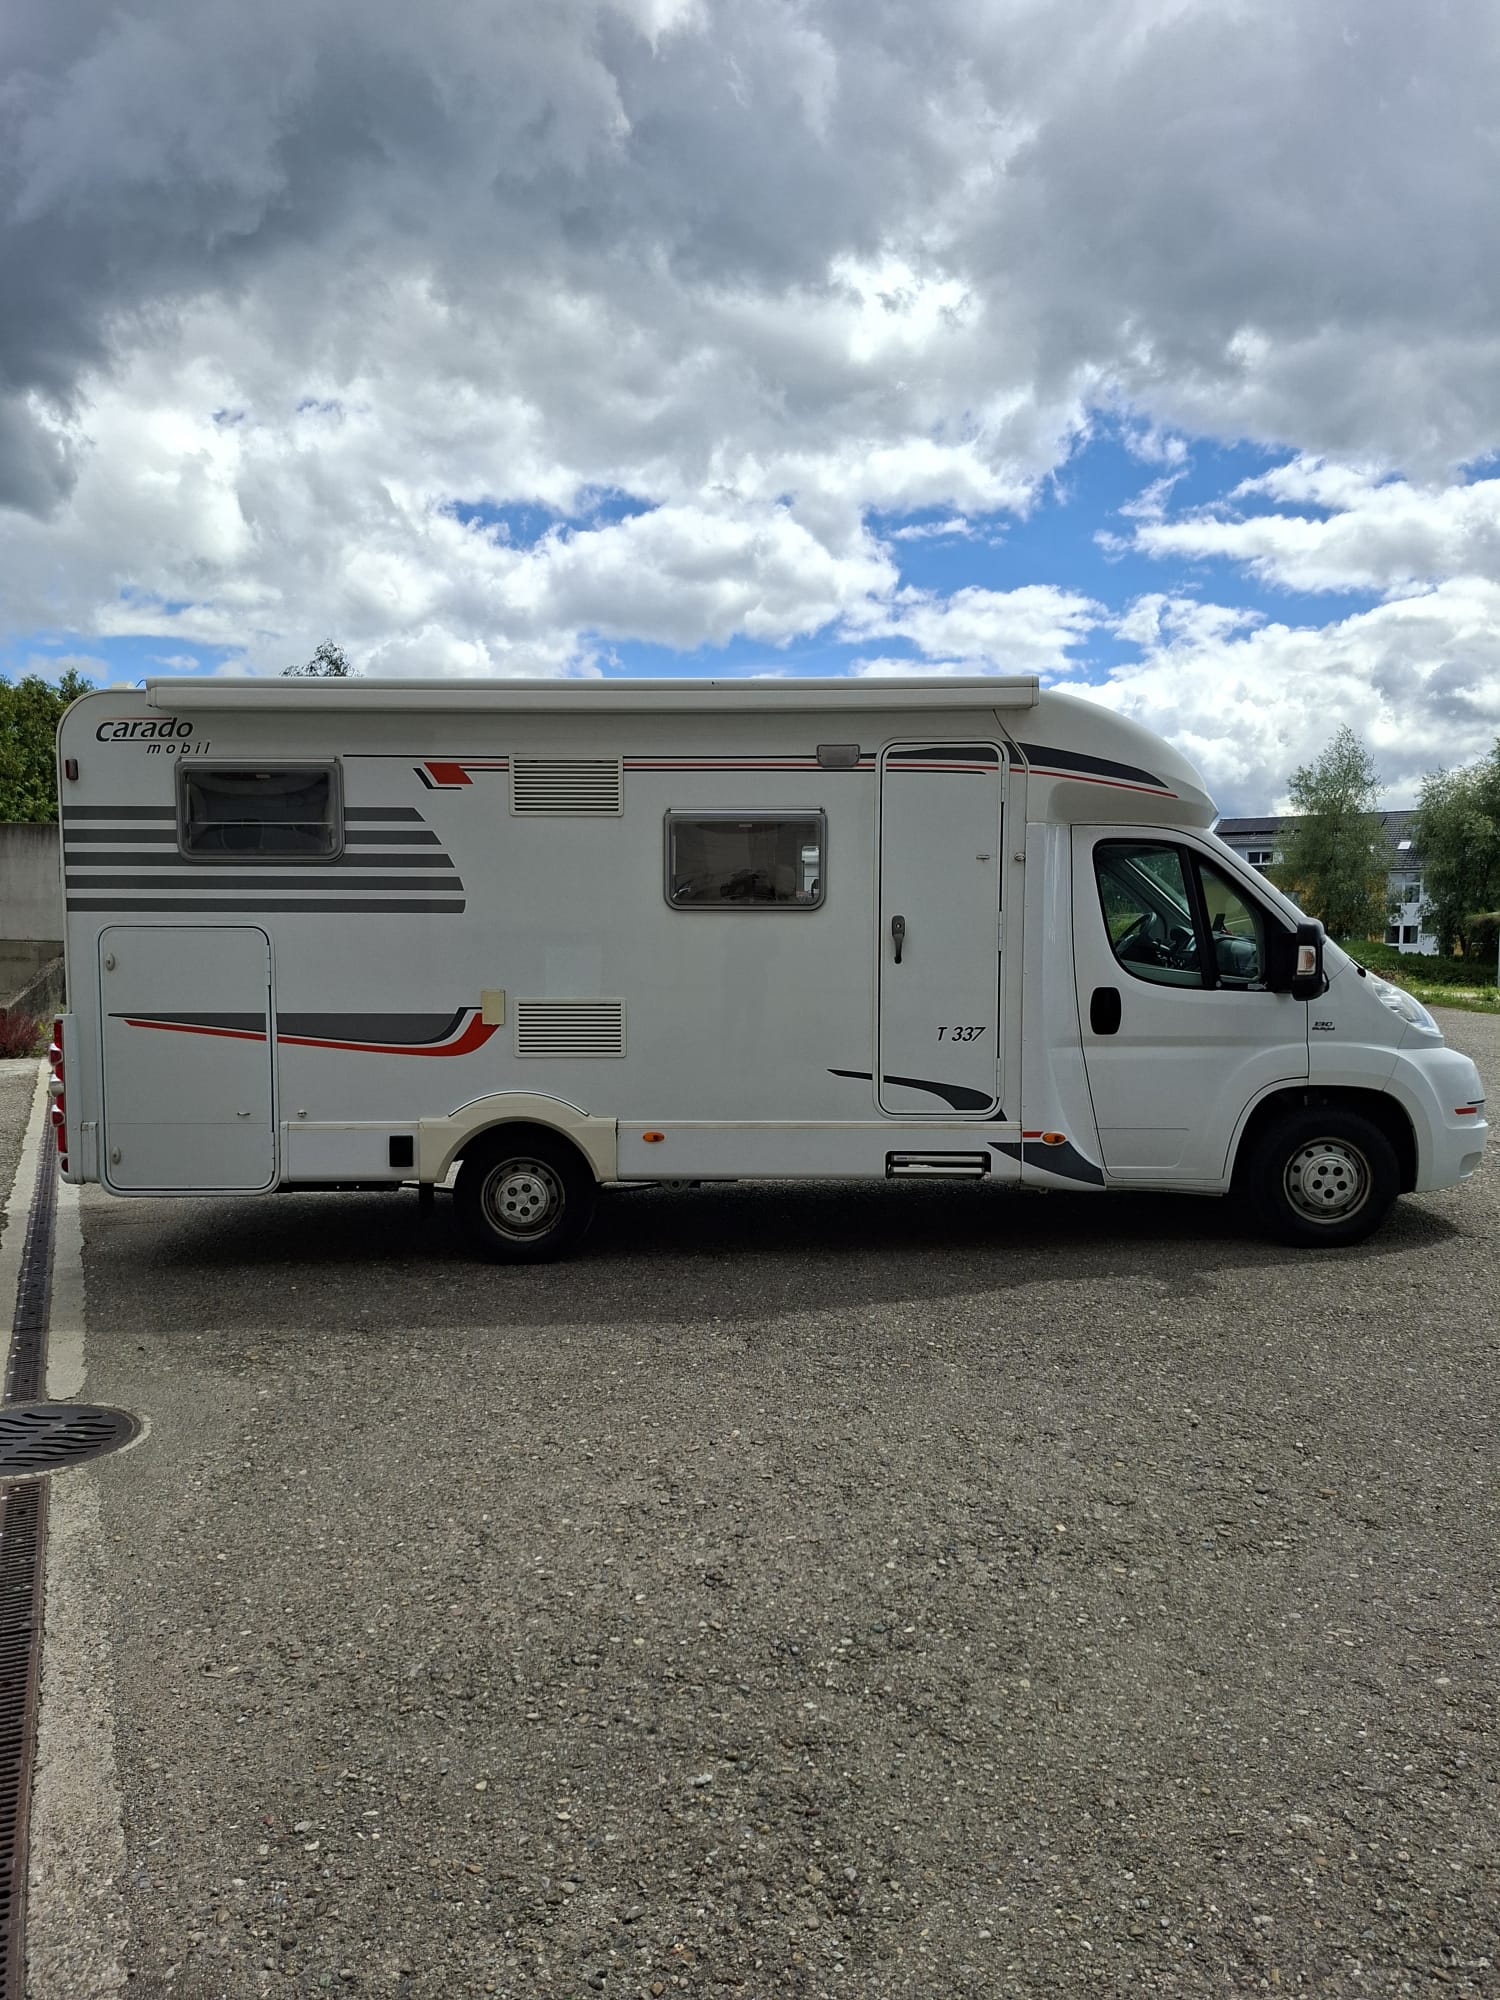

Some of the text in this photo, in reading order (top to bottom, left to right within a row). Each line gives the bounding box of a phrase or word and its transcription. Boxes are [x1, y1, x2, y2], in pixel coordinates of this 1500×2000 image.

[146, 742, 211, 754] mobil
[937, 1026, 986, 1041] T 337
